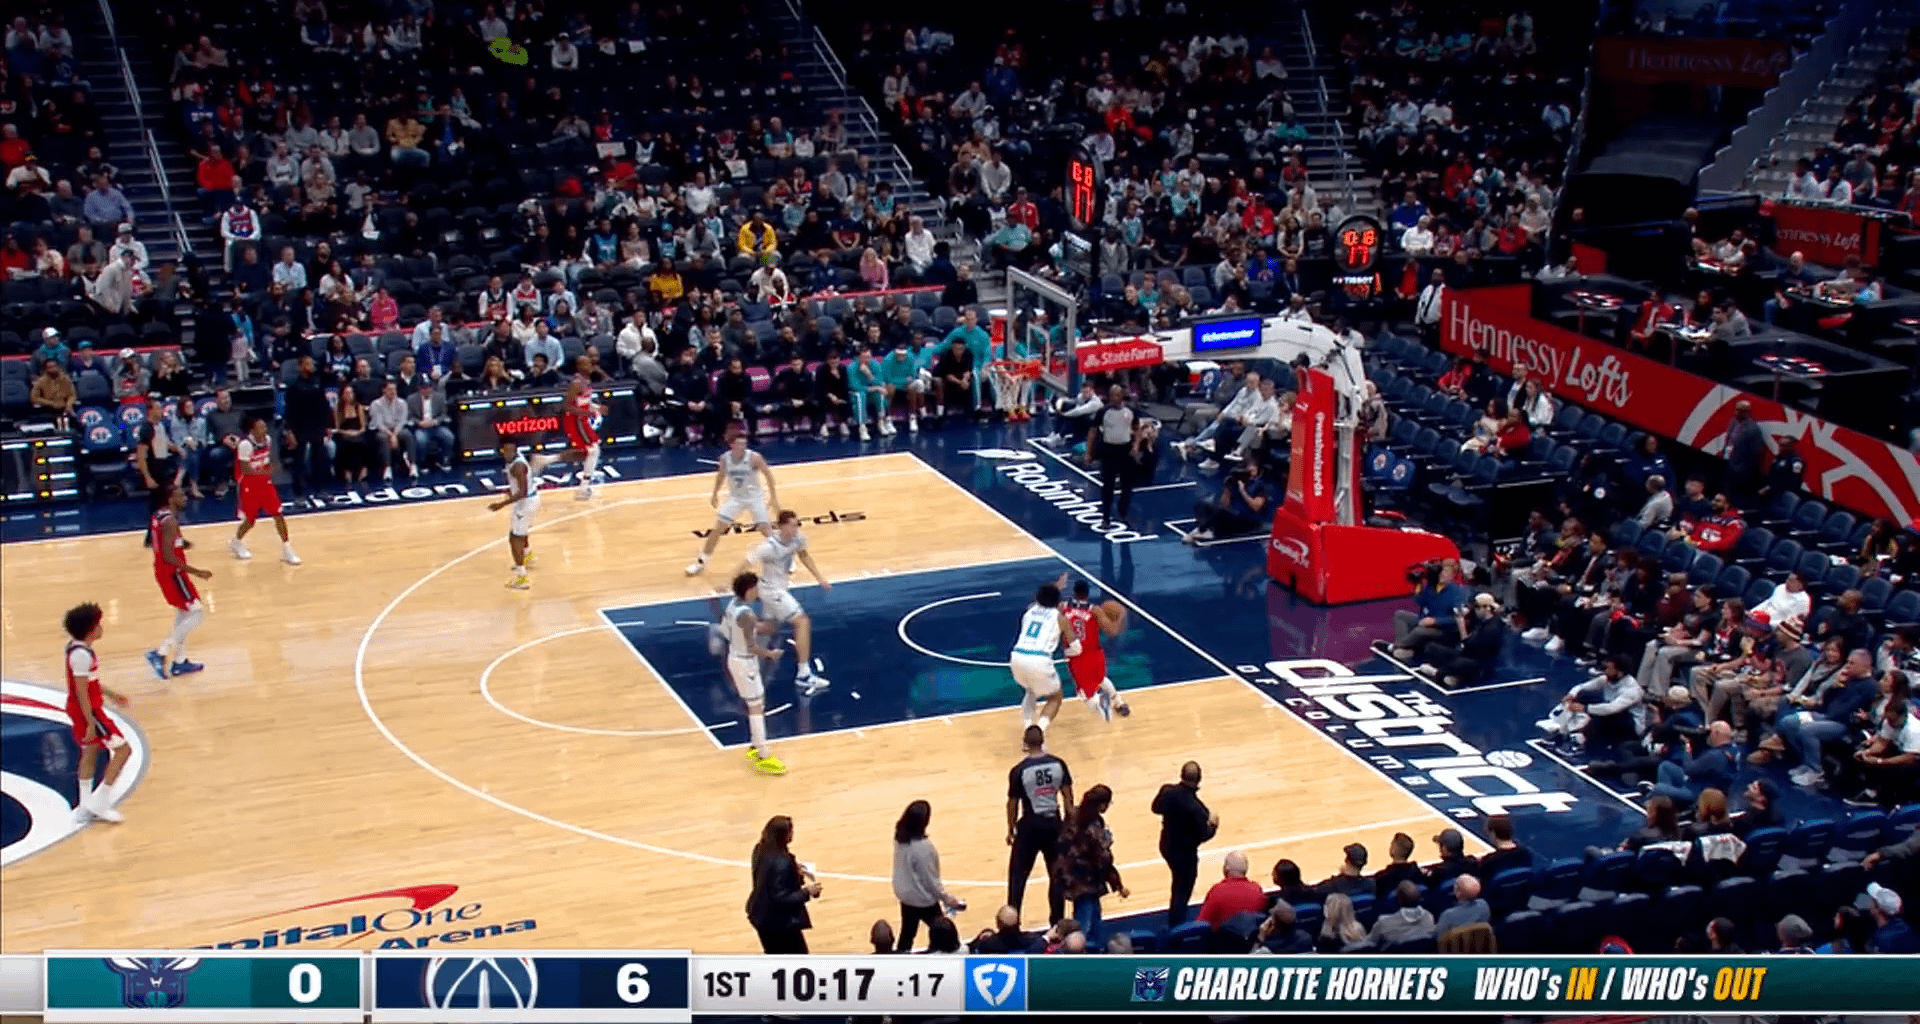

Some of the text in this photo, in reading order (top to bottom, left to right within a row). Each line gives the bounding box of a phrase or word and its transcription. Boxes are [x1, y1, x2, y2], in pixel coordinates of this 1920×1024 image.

[1450, 301, 1633, 408] Hennessy Lofts
[496, 414, 559, 435] verizon
[996, 462, 1160, 543] Robinhood
[692, 511, 867, 538] wizrds
[1395, 690, 1454, 716] THE
[1236, 665, 1479, 818] OF COLUMBIA
[1035, 768, 1052, 786] 85
[379, 919, 537, 949] Arena
